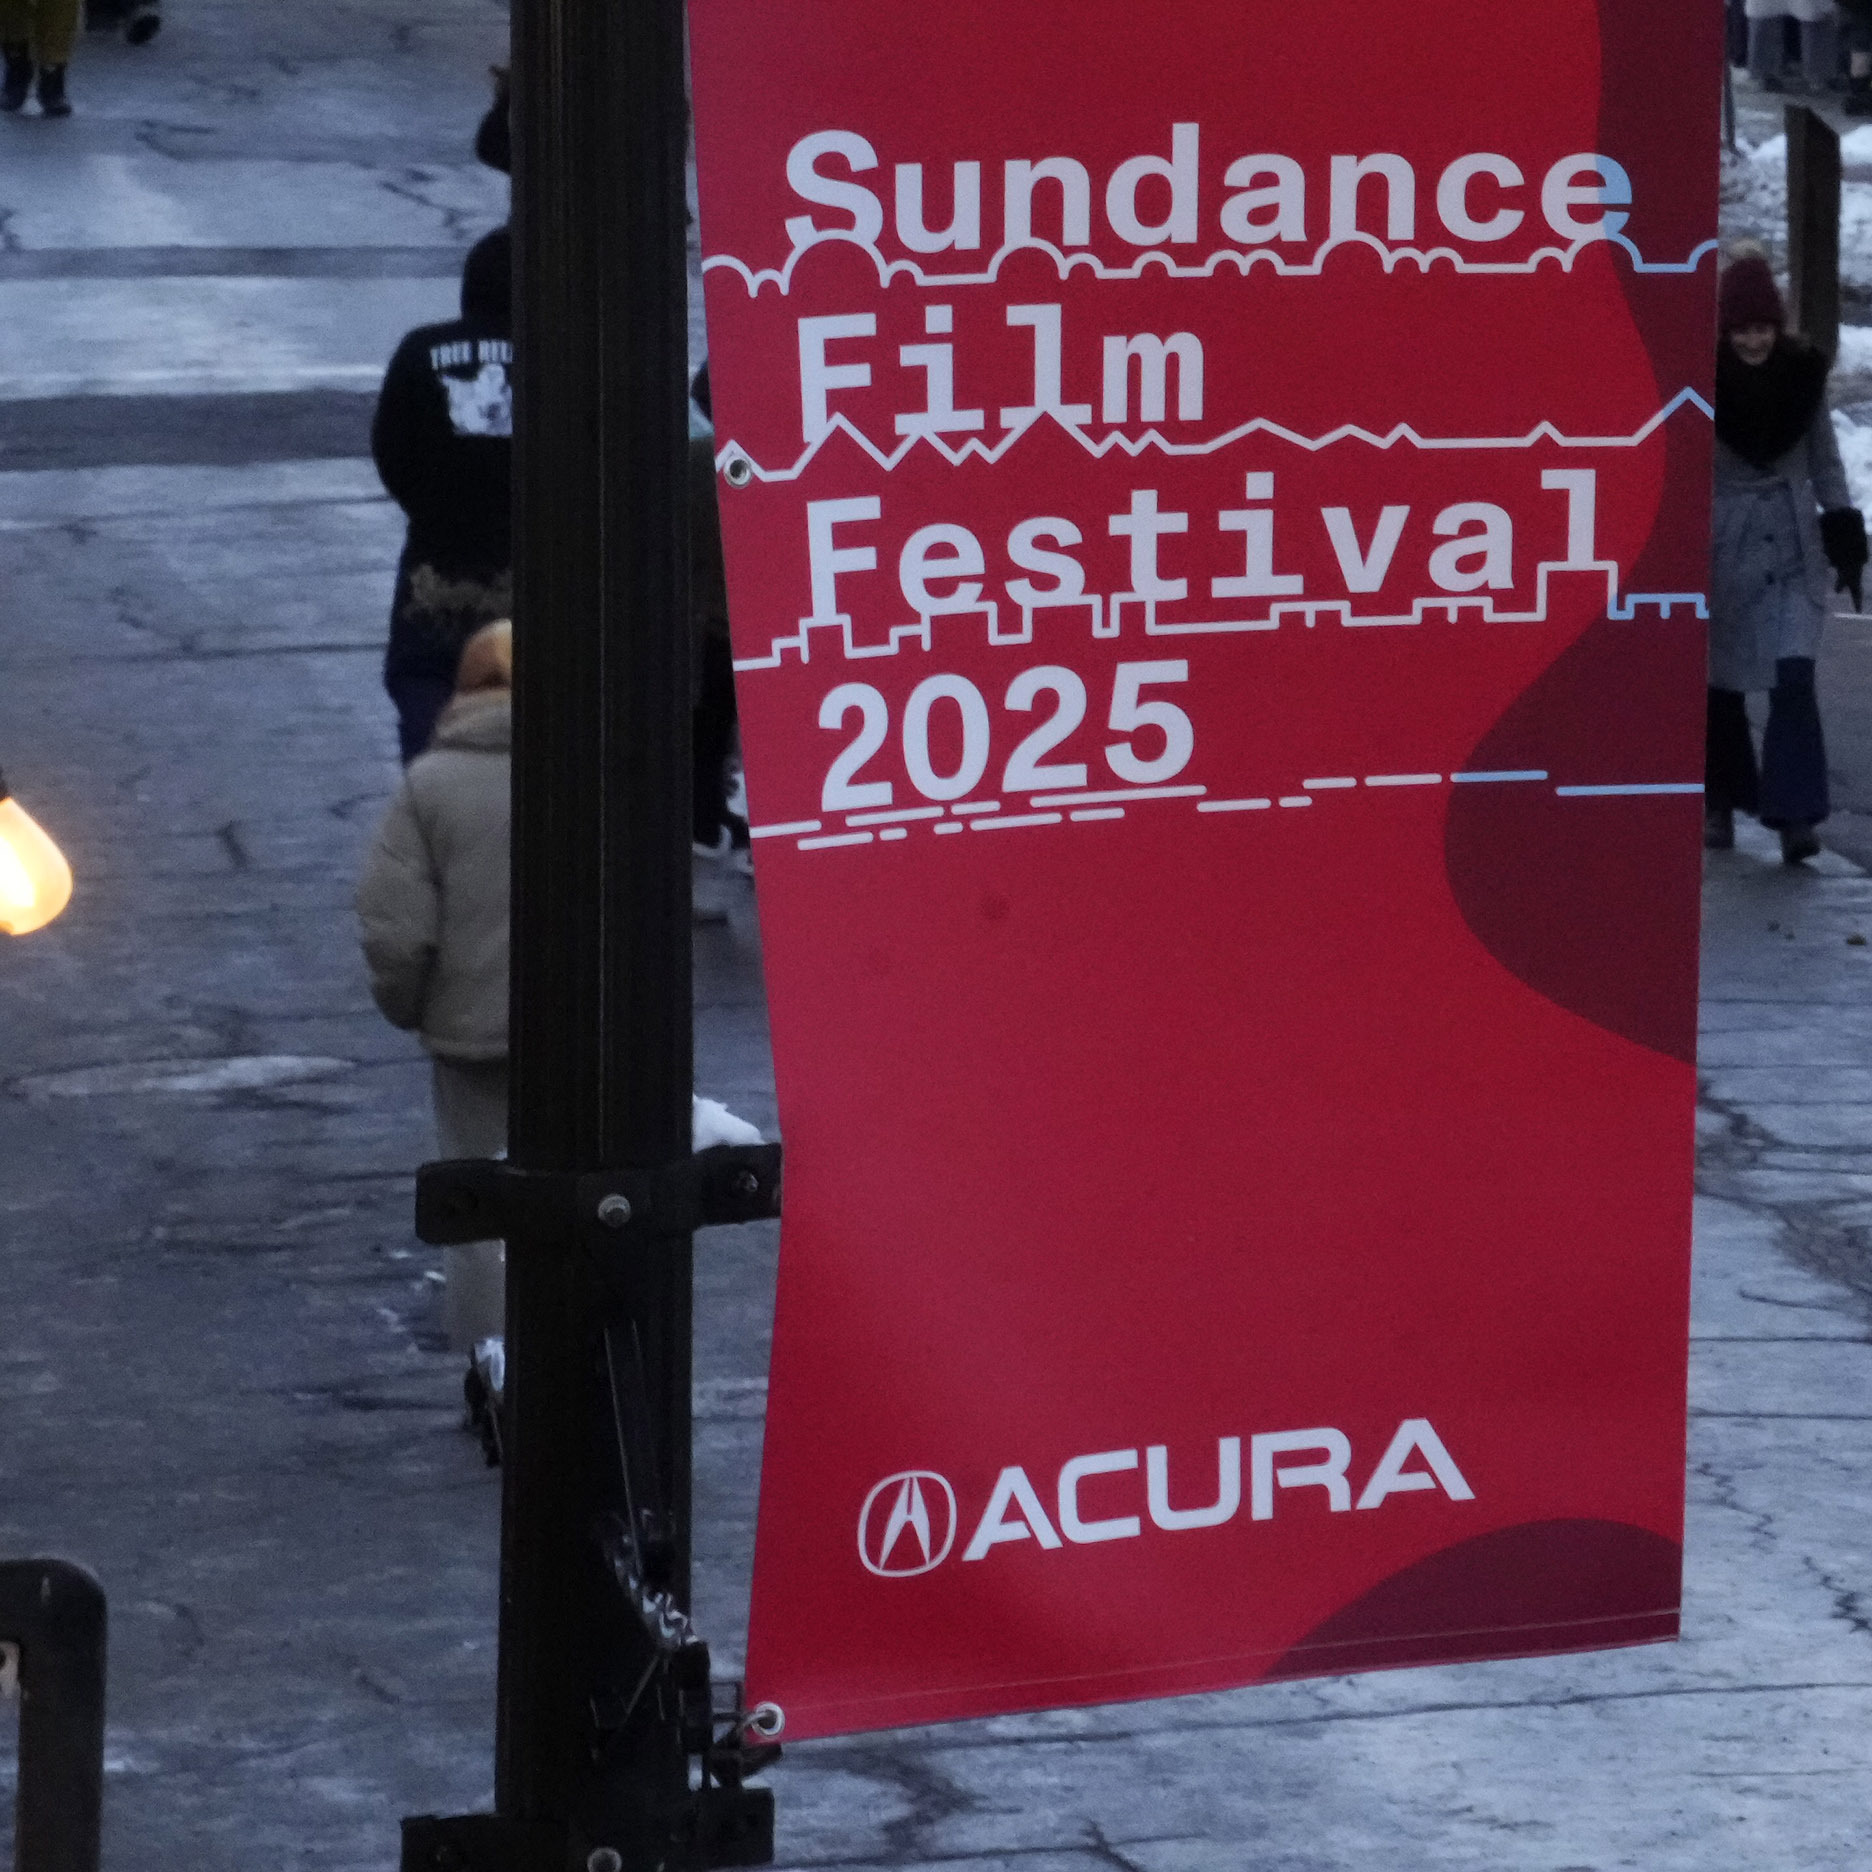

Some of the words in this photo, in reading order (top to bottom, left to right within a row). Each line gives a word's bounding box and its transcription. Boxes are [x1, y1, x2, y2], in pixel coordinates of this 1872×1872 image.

[785, 122, 1633, 253] Sundance
[798, 304, 1204, 444] Film
[806, 468, 1597, 620] Festival
[818, 659, 1195, 812] 2025
[962, 1418, 1476, 1562] ACURA
